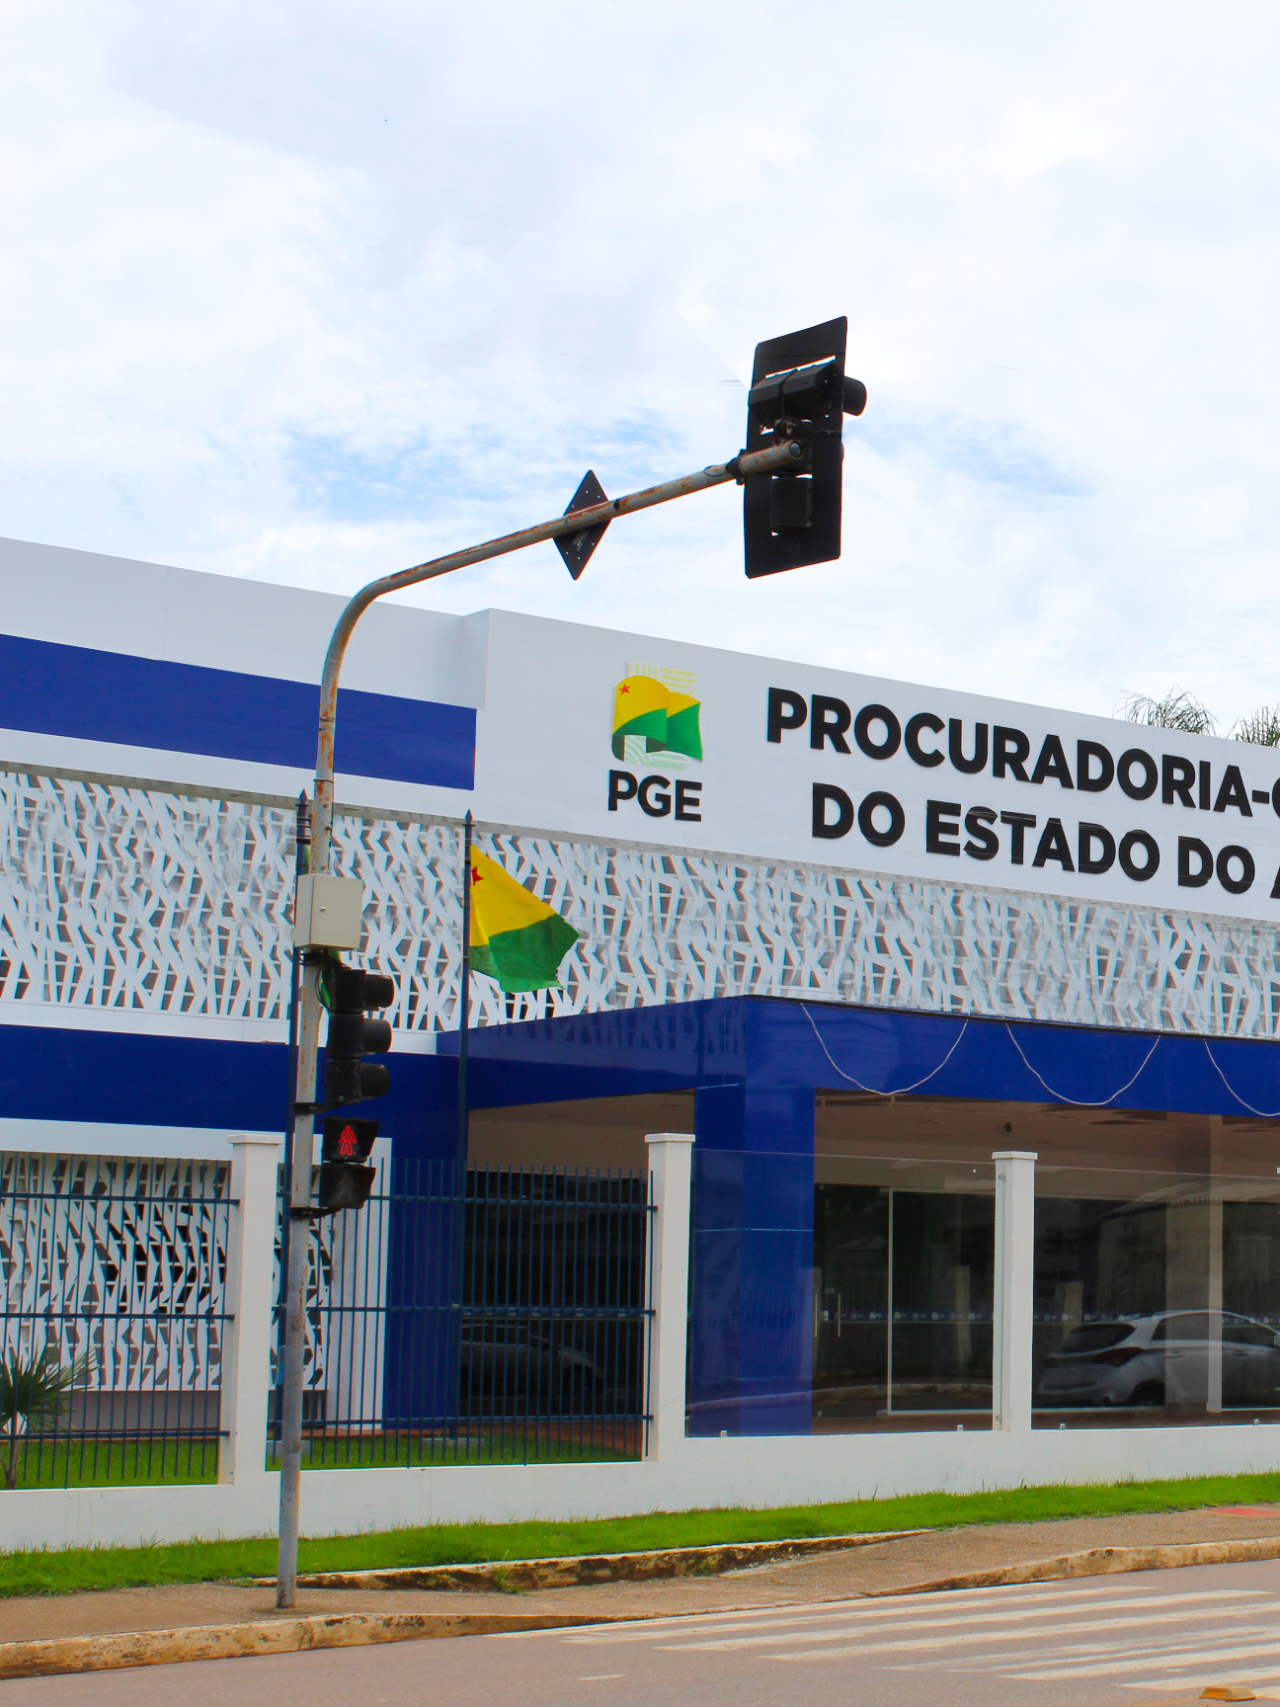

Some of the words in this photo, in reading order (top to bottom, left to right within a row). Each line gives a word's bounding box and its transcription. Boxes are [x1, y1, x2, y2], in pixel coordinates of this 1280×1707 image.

[607, 769, 702, 823] PGE
[811, 782, 906, 848] DO
[926, 798, 1160, 882] ESTADO
[1177, 835, 1256, 895] DO
